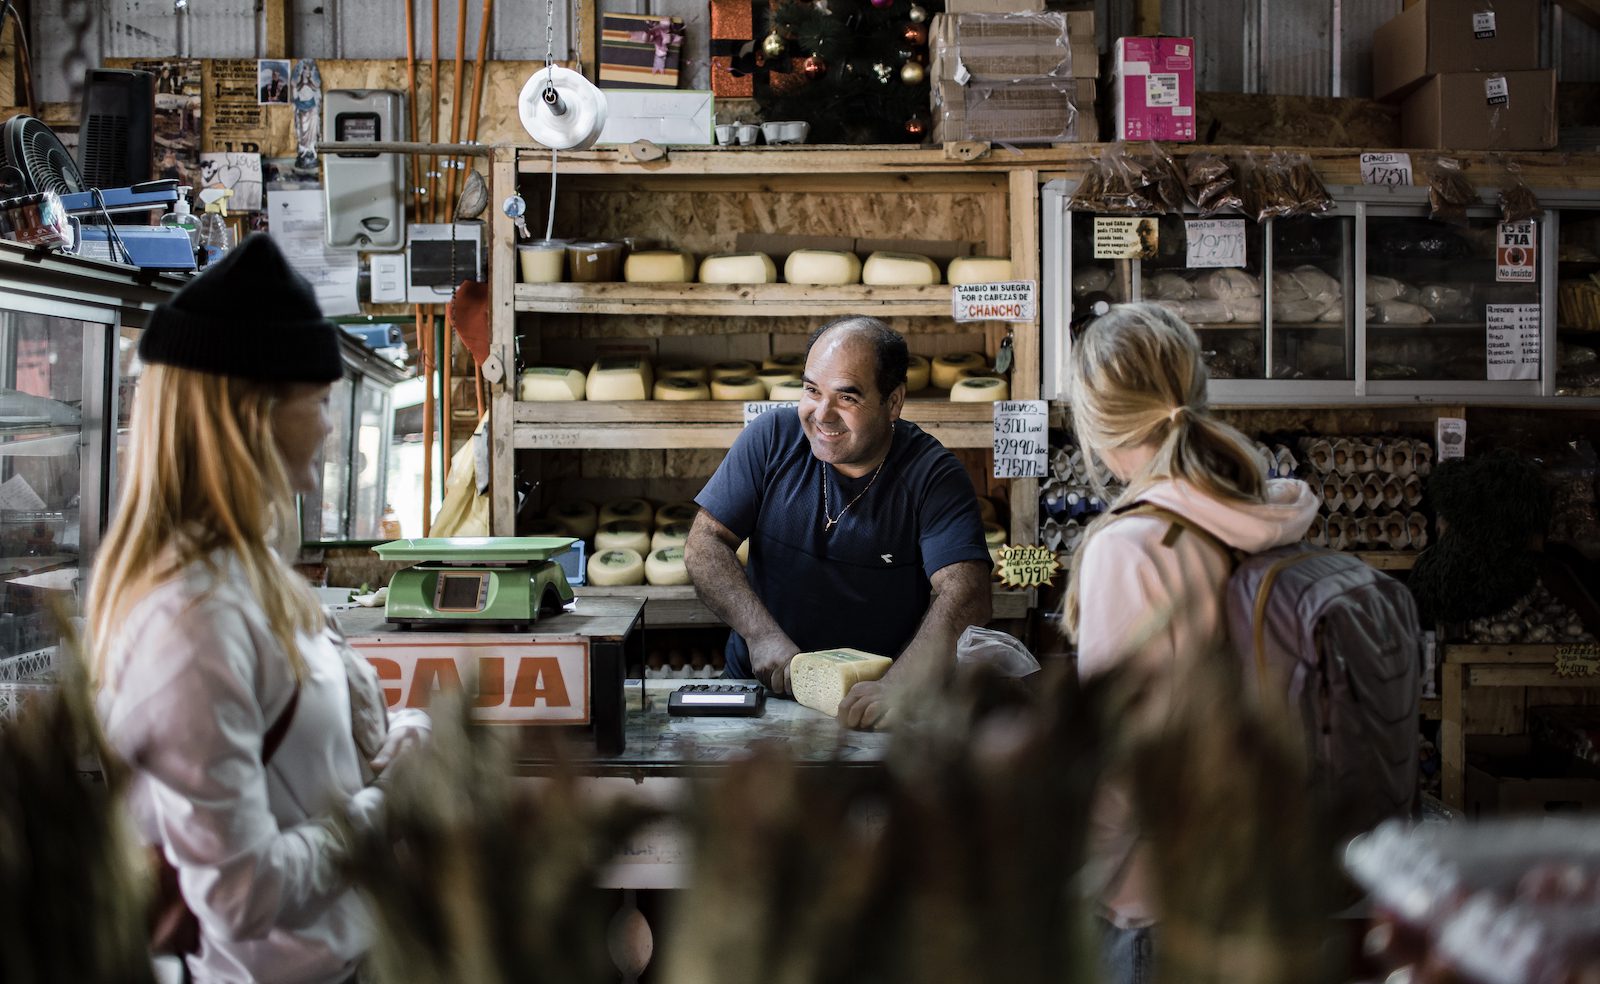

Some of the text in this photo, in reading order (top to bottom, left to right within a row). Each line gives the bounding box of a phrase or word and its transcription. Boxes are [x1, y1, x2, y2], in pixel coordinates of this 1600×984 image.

[1502, 224, 1531, 233] NO SE
[1505, 234, 1529, 245] FIA
[1500, 269, 1509, 277] No
[958, 283, 1031, 292] CAMBIO MI SUEGRA
[984, 293, 1017, 301] CABEZAS
[1019, 293, 1028, 301] DE
[969, 304, 1021, 317] CHANCHO
[1001, 402, 1037, 412] HUEVOS
[1002, 418, 1026, 433] 300
[1001, 438, 1034, 455] 2990
[1002, 458, 1037, 476] 7500
[1004, 549, 1051, 560] OFERTA
[1013, 567, 1049, 584] 4990
[365, 657, 571, 708] CAJA
